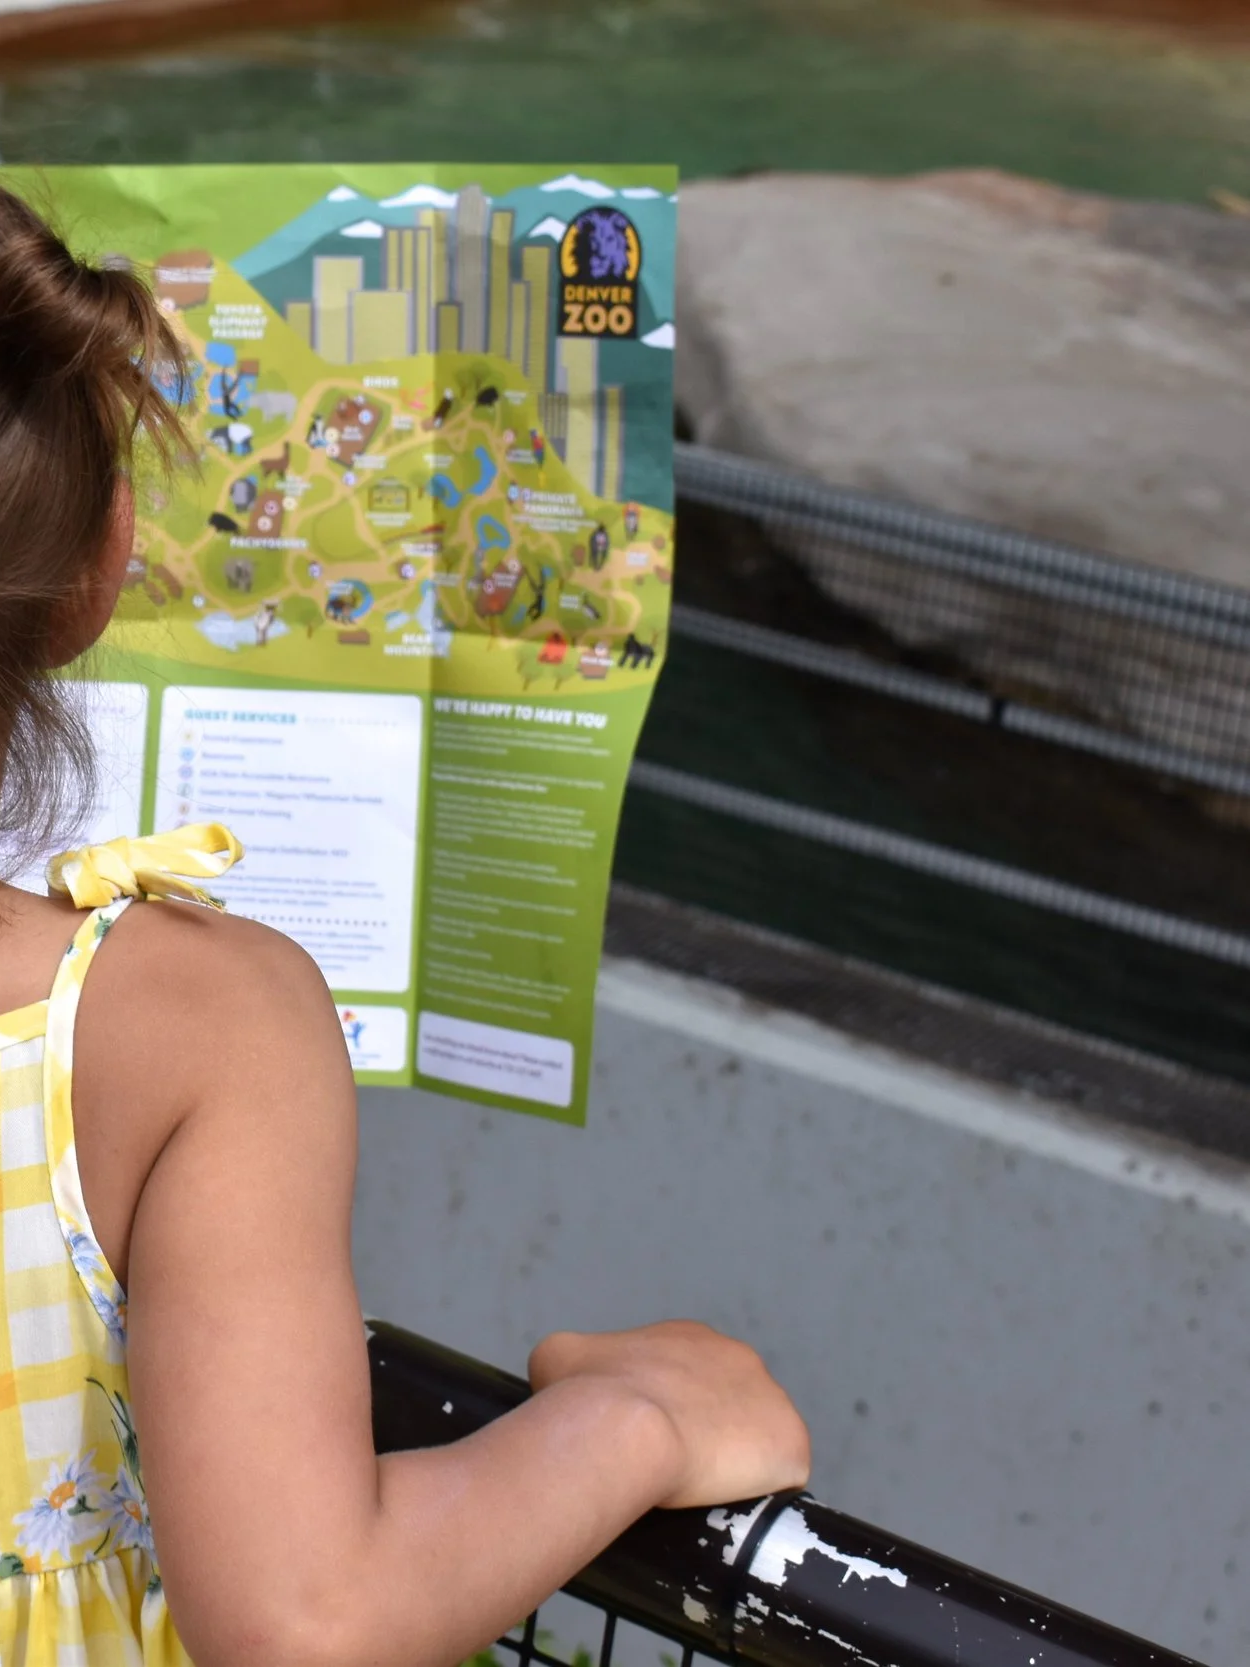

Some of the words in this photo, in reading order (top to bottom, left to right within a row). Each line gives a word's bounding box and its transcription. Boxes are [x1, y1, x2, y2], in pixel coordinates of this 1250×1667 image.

[564, 284, 632, 303] DENVER
[563, 304, 633, 334] ZOO
[363, 376, 398, 388] BIRDS
[184, 708, 228, 722] GUEST
[231, 709, 297, 724] SERVICES
[470, 701, 513, 719] HAPPY
[515, 705, 534, 721] TO
[534, 707, 573, 726] HAVE
[575, 712, 608, 729] YOU
